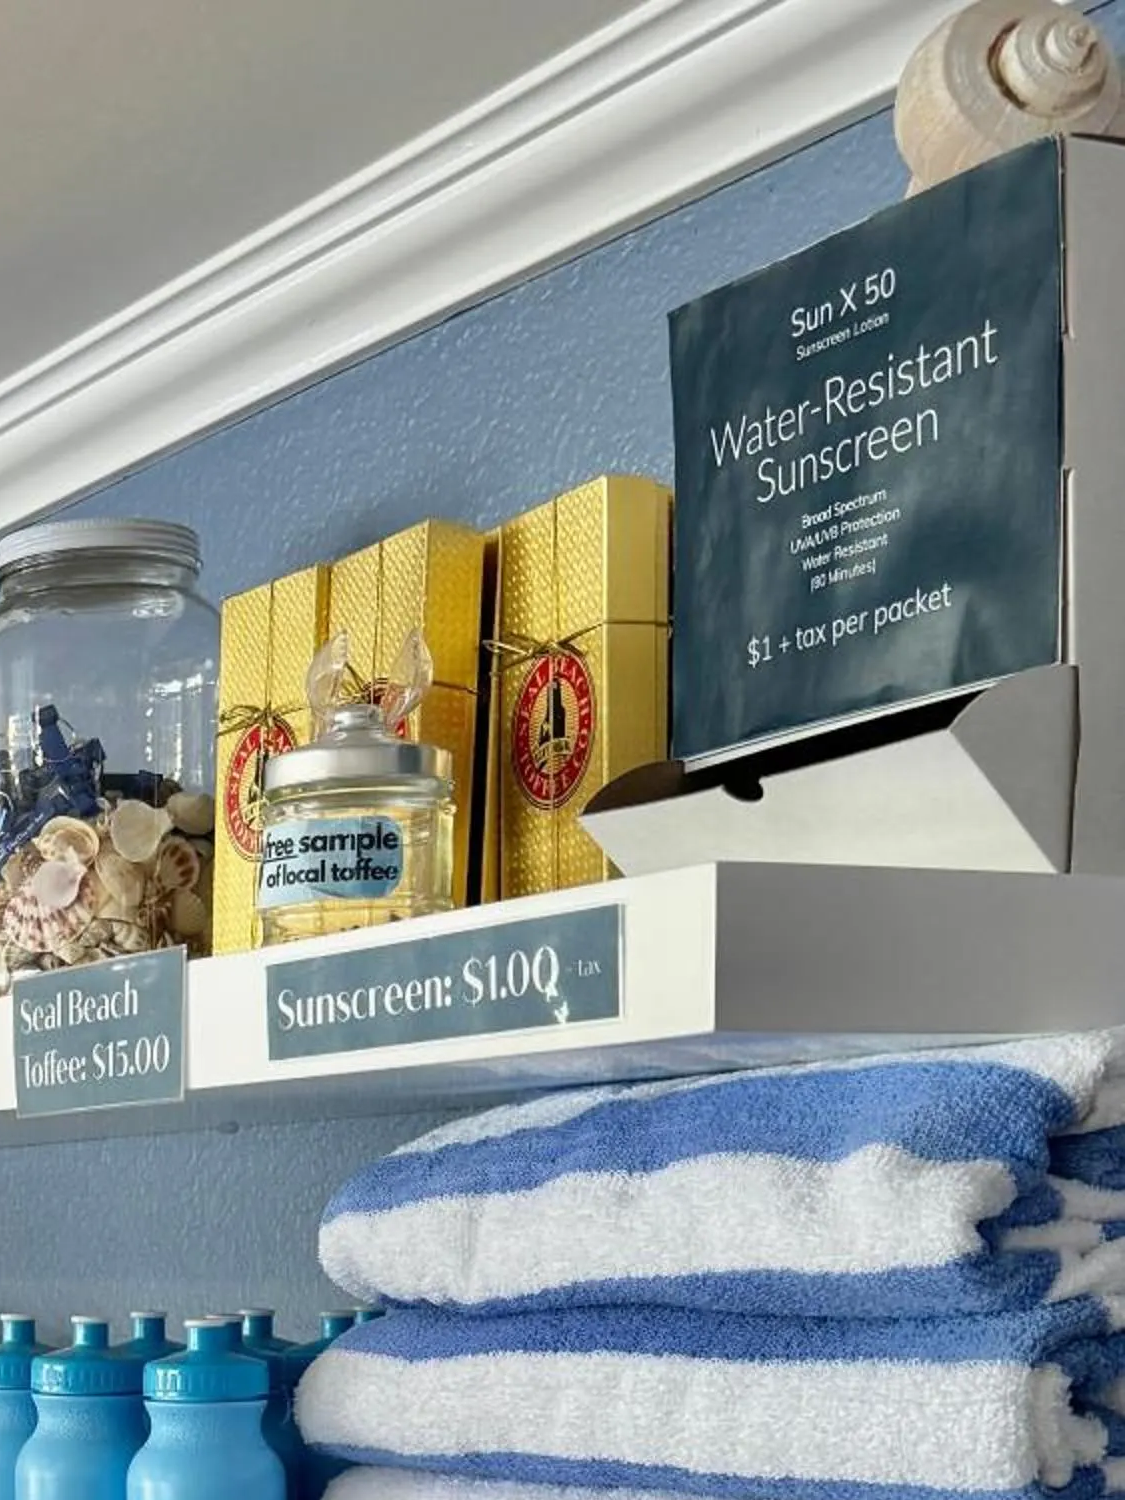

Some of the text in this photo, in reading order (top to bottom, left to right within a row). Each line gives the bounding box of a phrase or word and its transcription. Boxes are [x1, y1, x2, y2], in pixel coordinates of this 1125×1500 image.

[791, 267, 896, 337] Sun X 50
[796, 312, 890, 361] Sunscreen Lotion
[710, 318, 1000, 468] Water-Resistant
[756, 407, 939, 503] Sunscreen
[801, 489, 887, 529] Broad Spectrum
[840, 507, 900, 535] Protection
[801, 533, 888, 572] Water Resistant
[747, 582, 953, 668] $1 + tax per packet
[265, 822, 399, 858] free sample
[281, 859, 326, 885] local
[331, 857, 399, 883] toffee
[20, 978, 139, 1035] Seal Beach
[277, 976, 452, 1030] Sunscreen:
[462, 945, 560, 1005] $1.00
[23, 1033, 171, 1088] Toffee: $15.00
